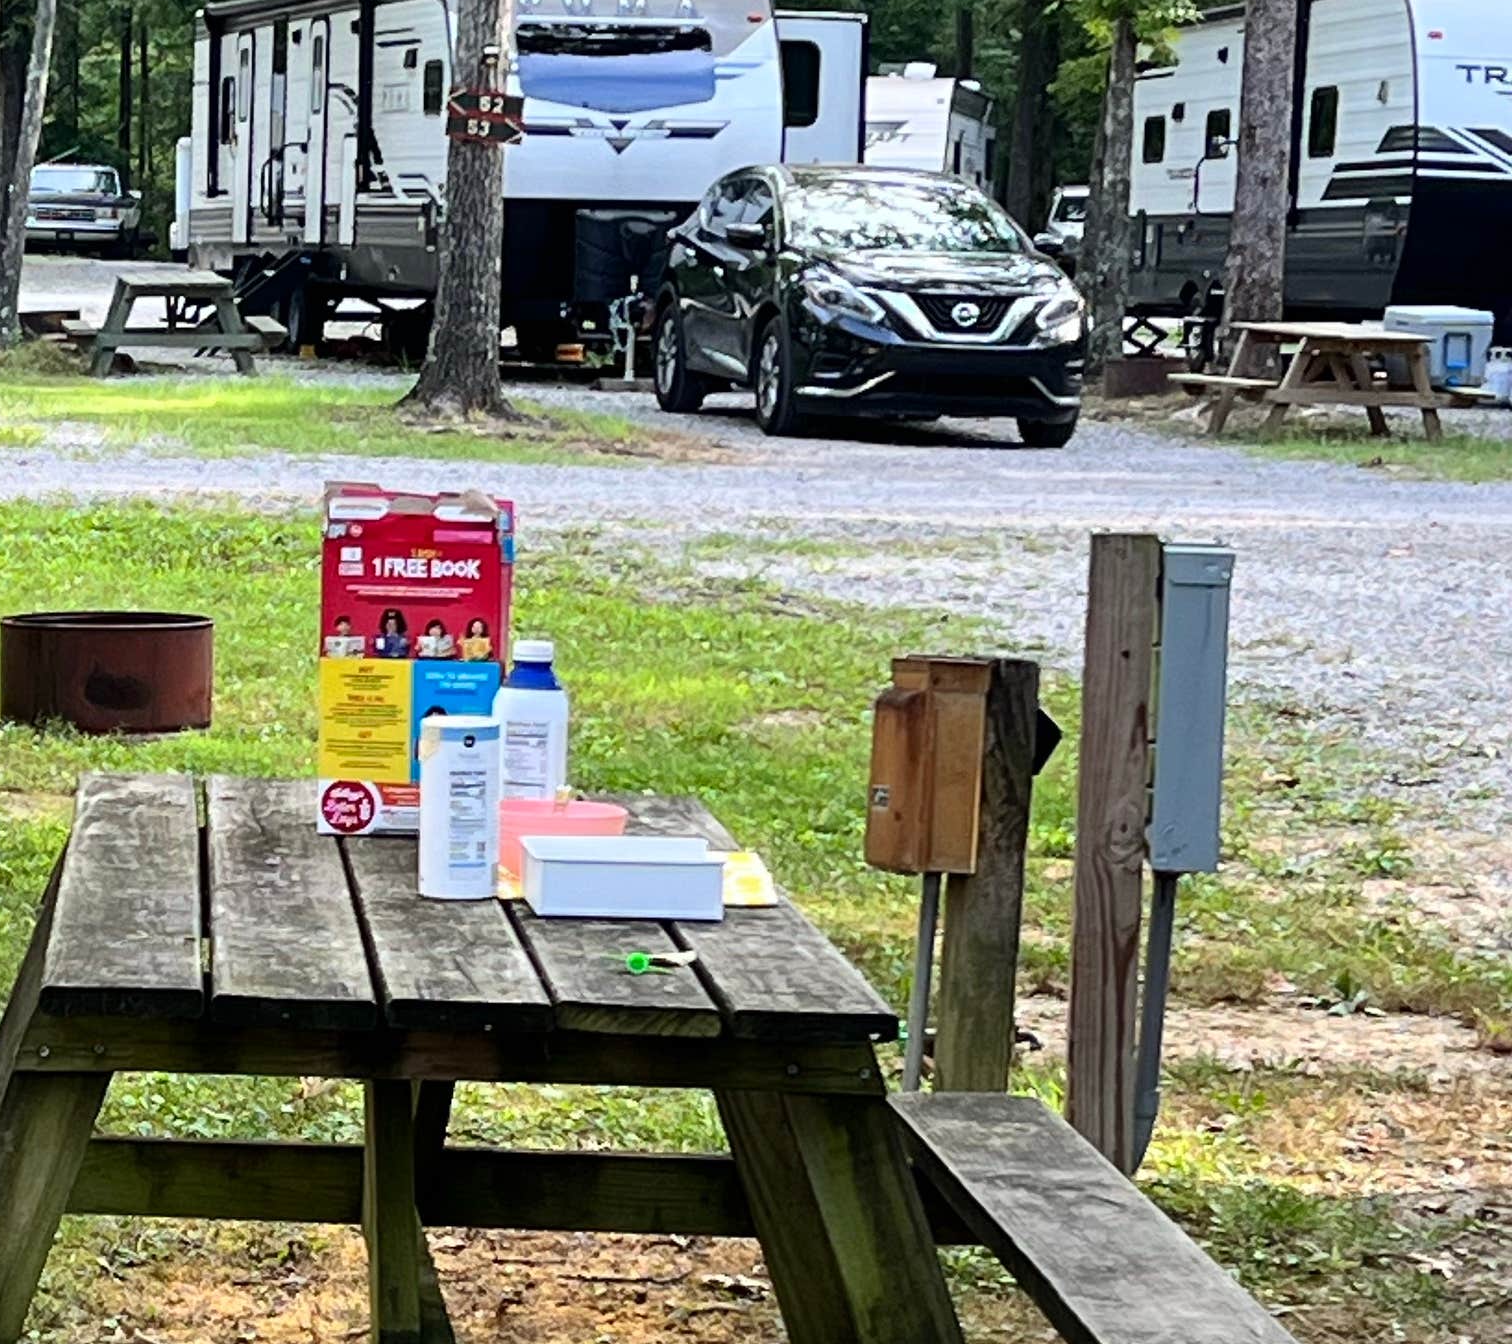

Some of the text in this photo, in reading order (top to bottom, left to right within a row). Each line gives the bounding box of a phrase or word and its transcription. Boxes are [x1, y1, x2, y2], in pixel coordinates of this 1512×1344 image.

[372, 556, 382, 577] 1
[383, 557, 428, 578] FREE
[430, 558, 481, 580] BOOK
